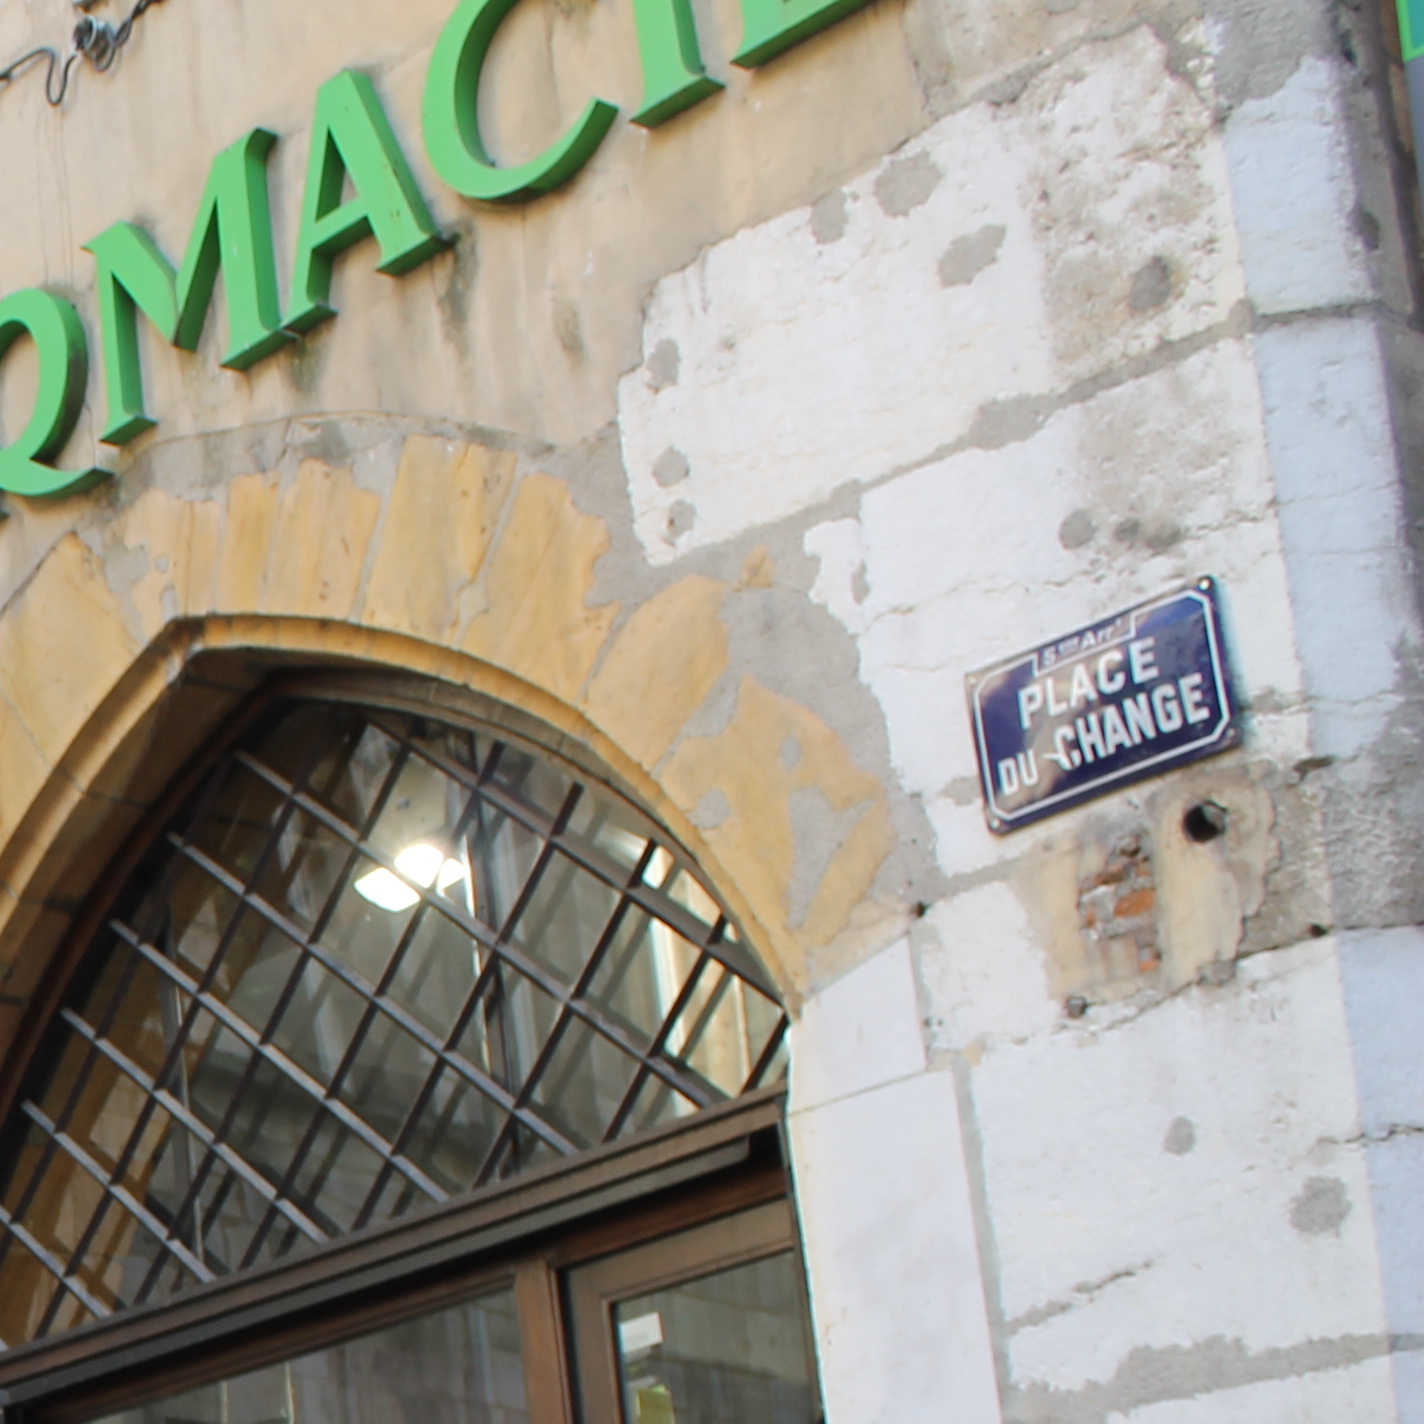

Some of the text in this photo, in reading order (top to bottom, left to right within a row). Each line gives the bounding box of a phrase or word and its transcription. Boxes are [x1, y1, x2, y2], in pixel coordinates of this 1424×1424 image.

[997, 672, 1212, 797] DU CHANGE
[1018, 636, 1160, 730] PLACE
